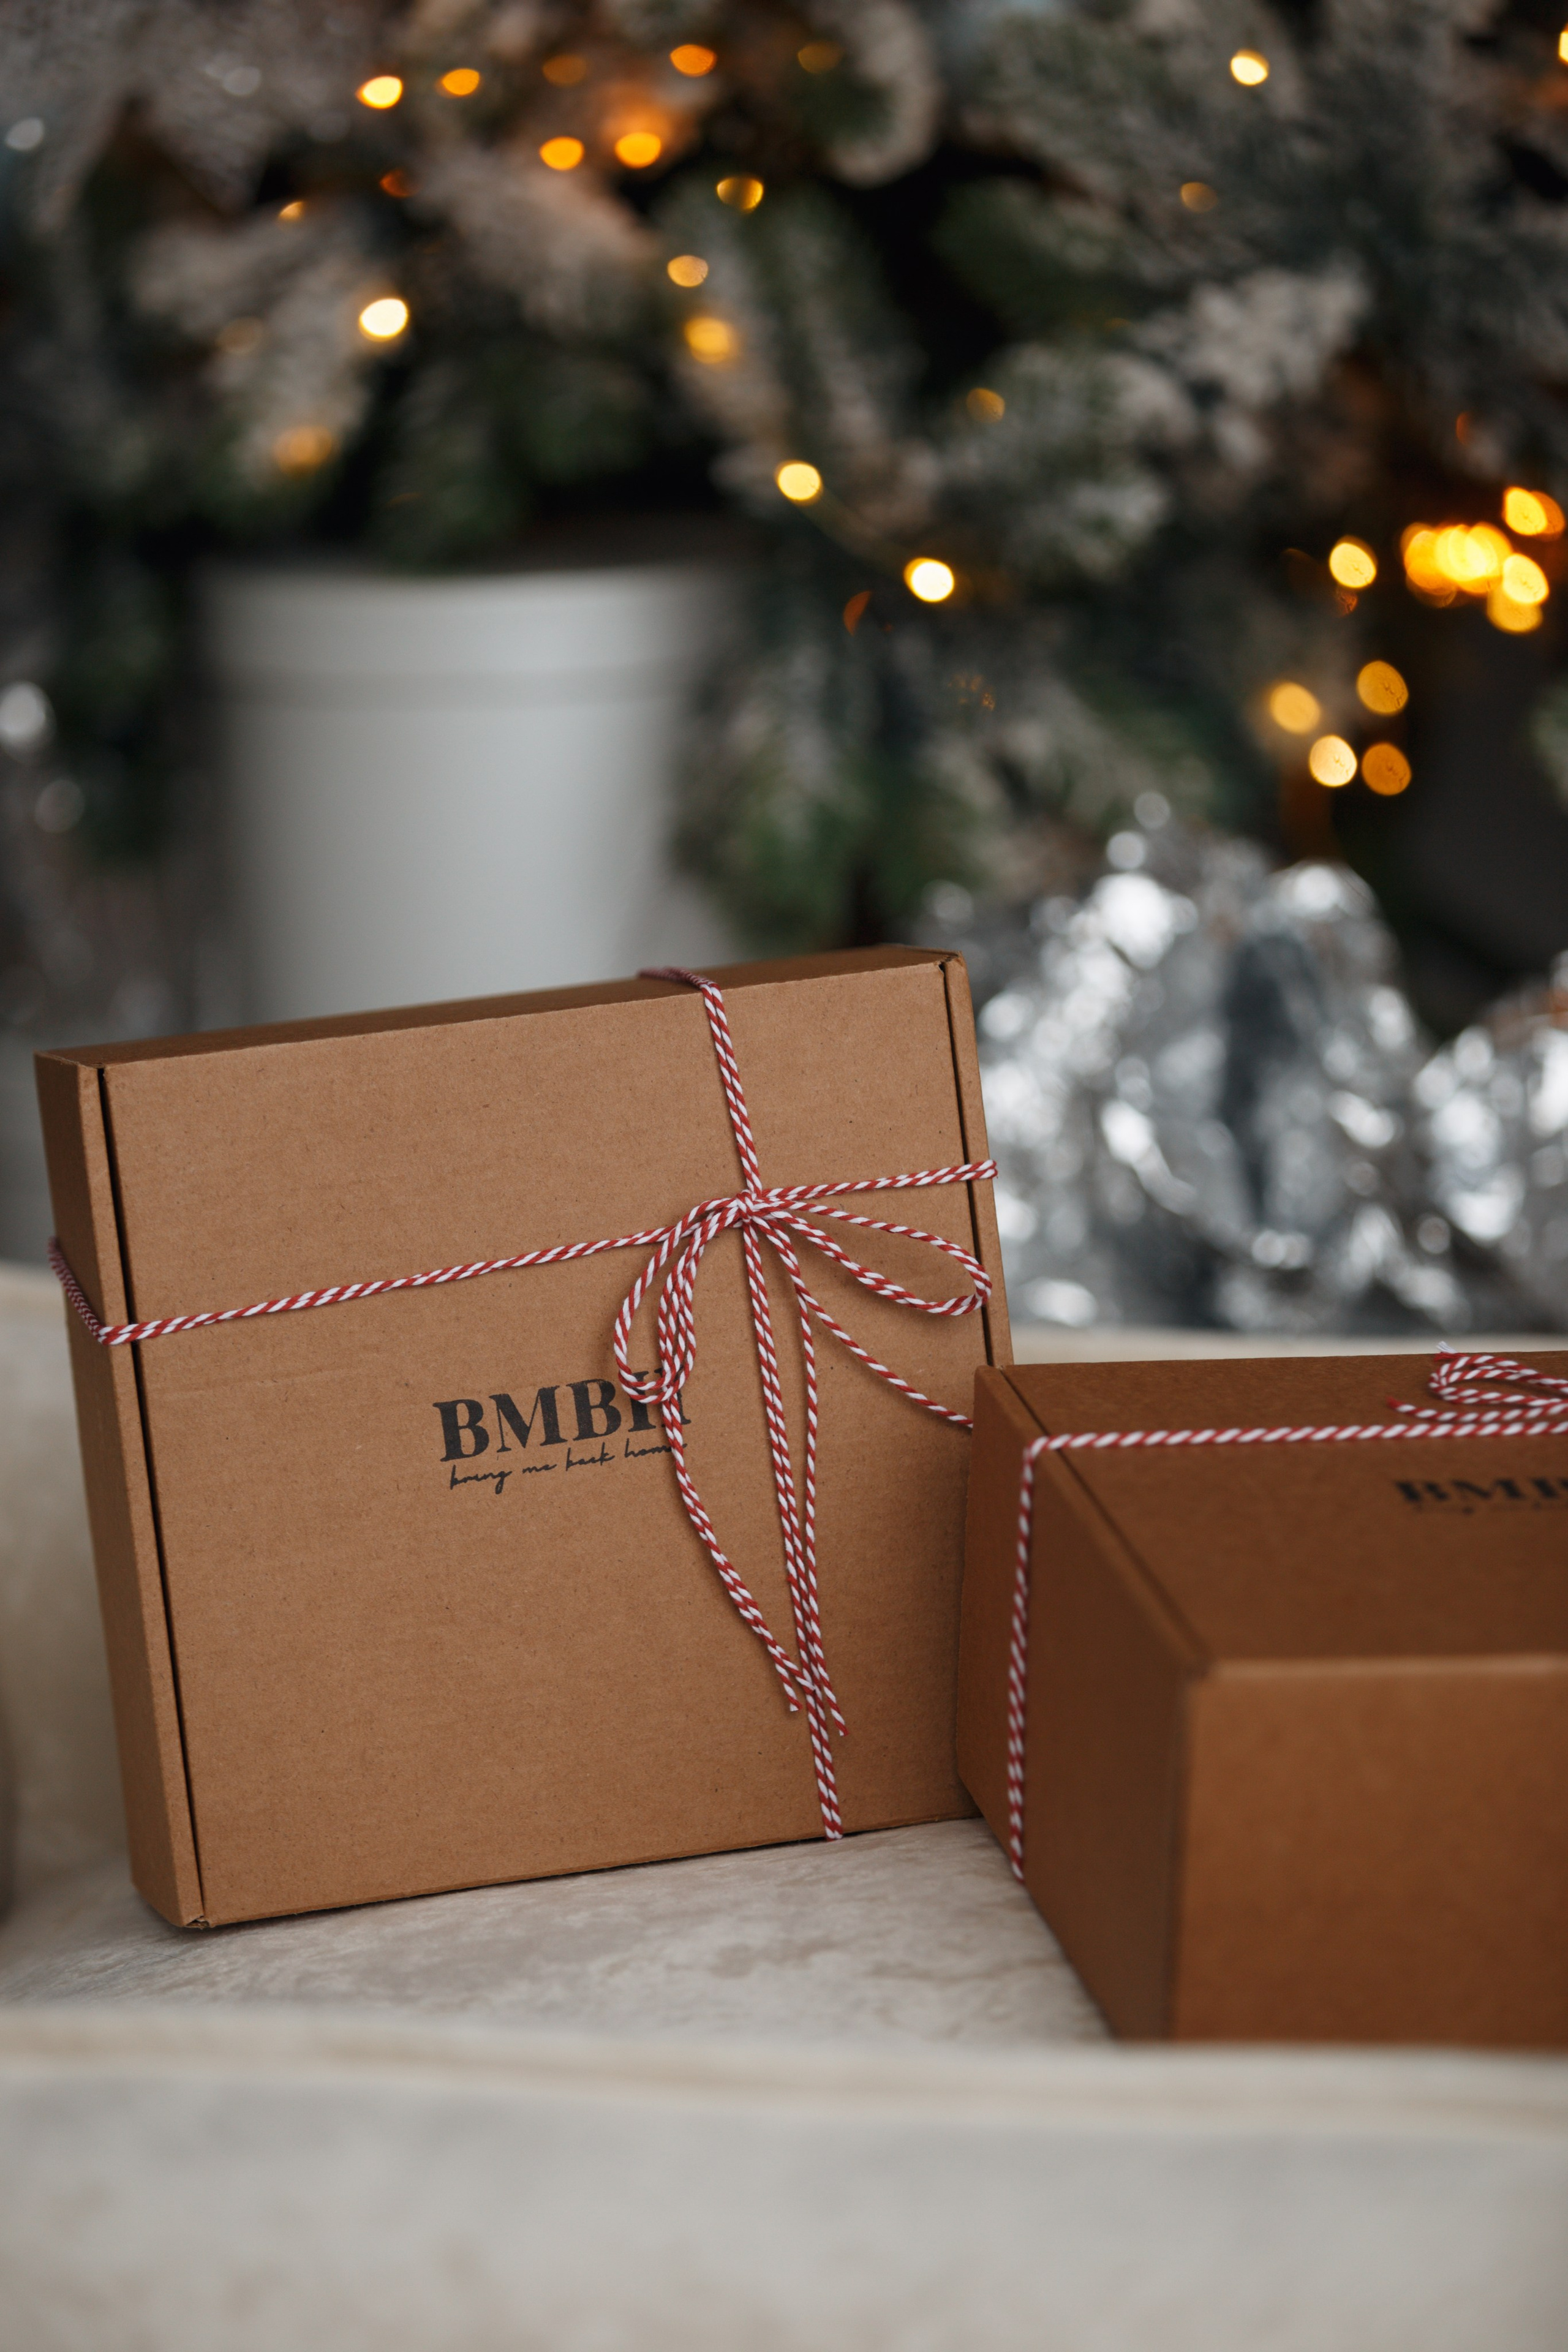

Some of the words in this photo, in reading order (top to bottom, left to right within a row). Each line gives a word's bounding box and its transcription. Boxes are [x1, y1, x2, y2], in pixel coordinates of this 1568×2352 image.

[450, 1464, 513, 1494] bring
[522, 1464, 558, 1474] me
[565, 1442, 616, 1471] back
